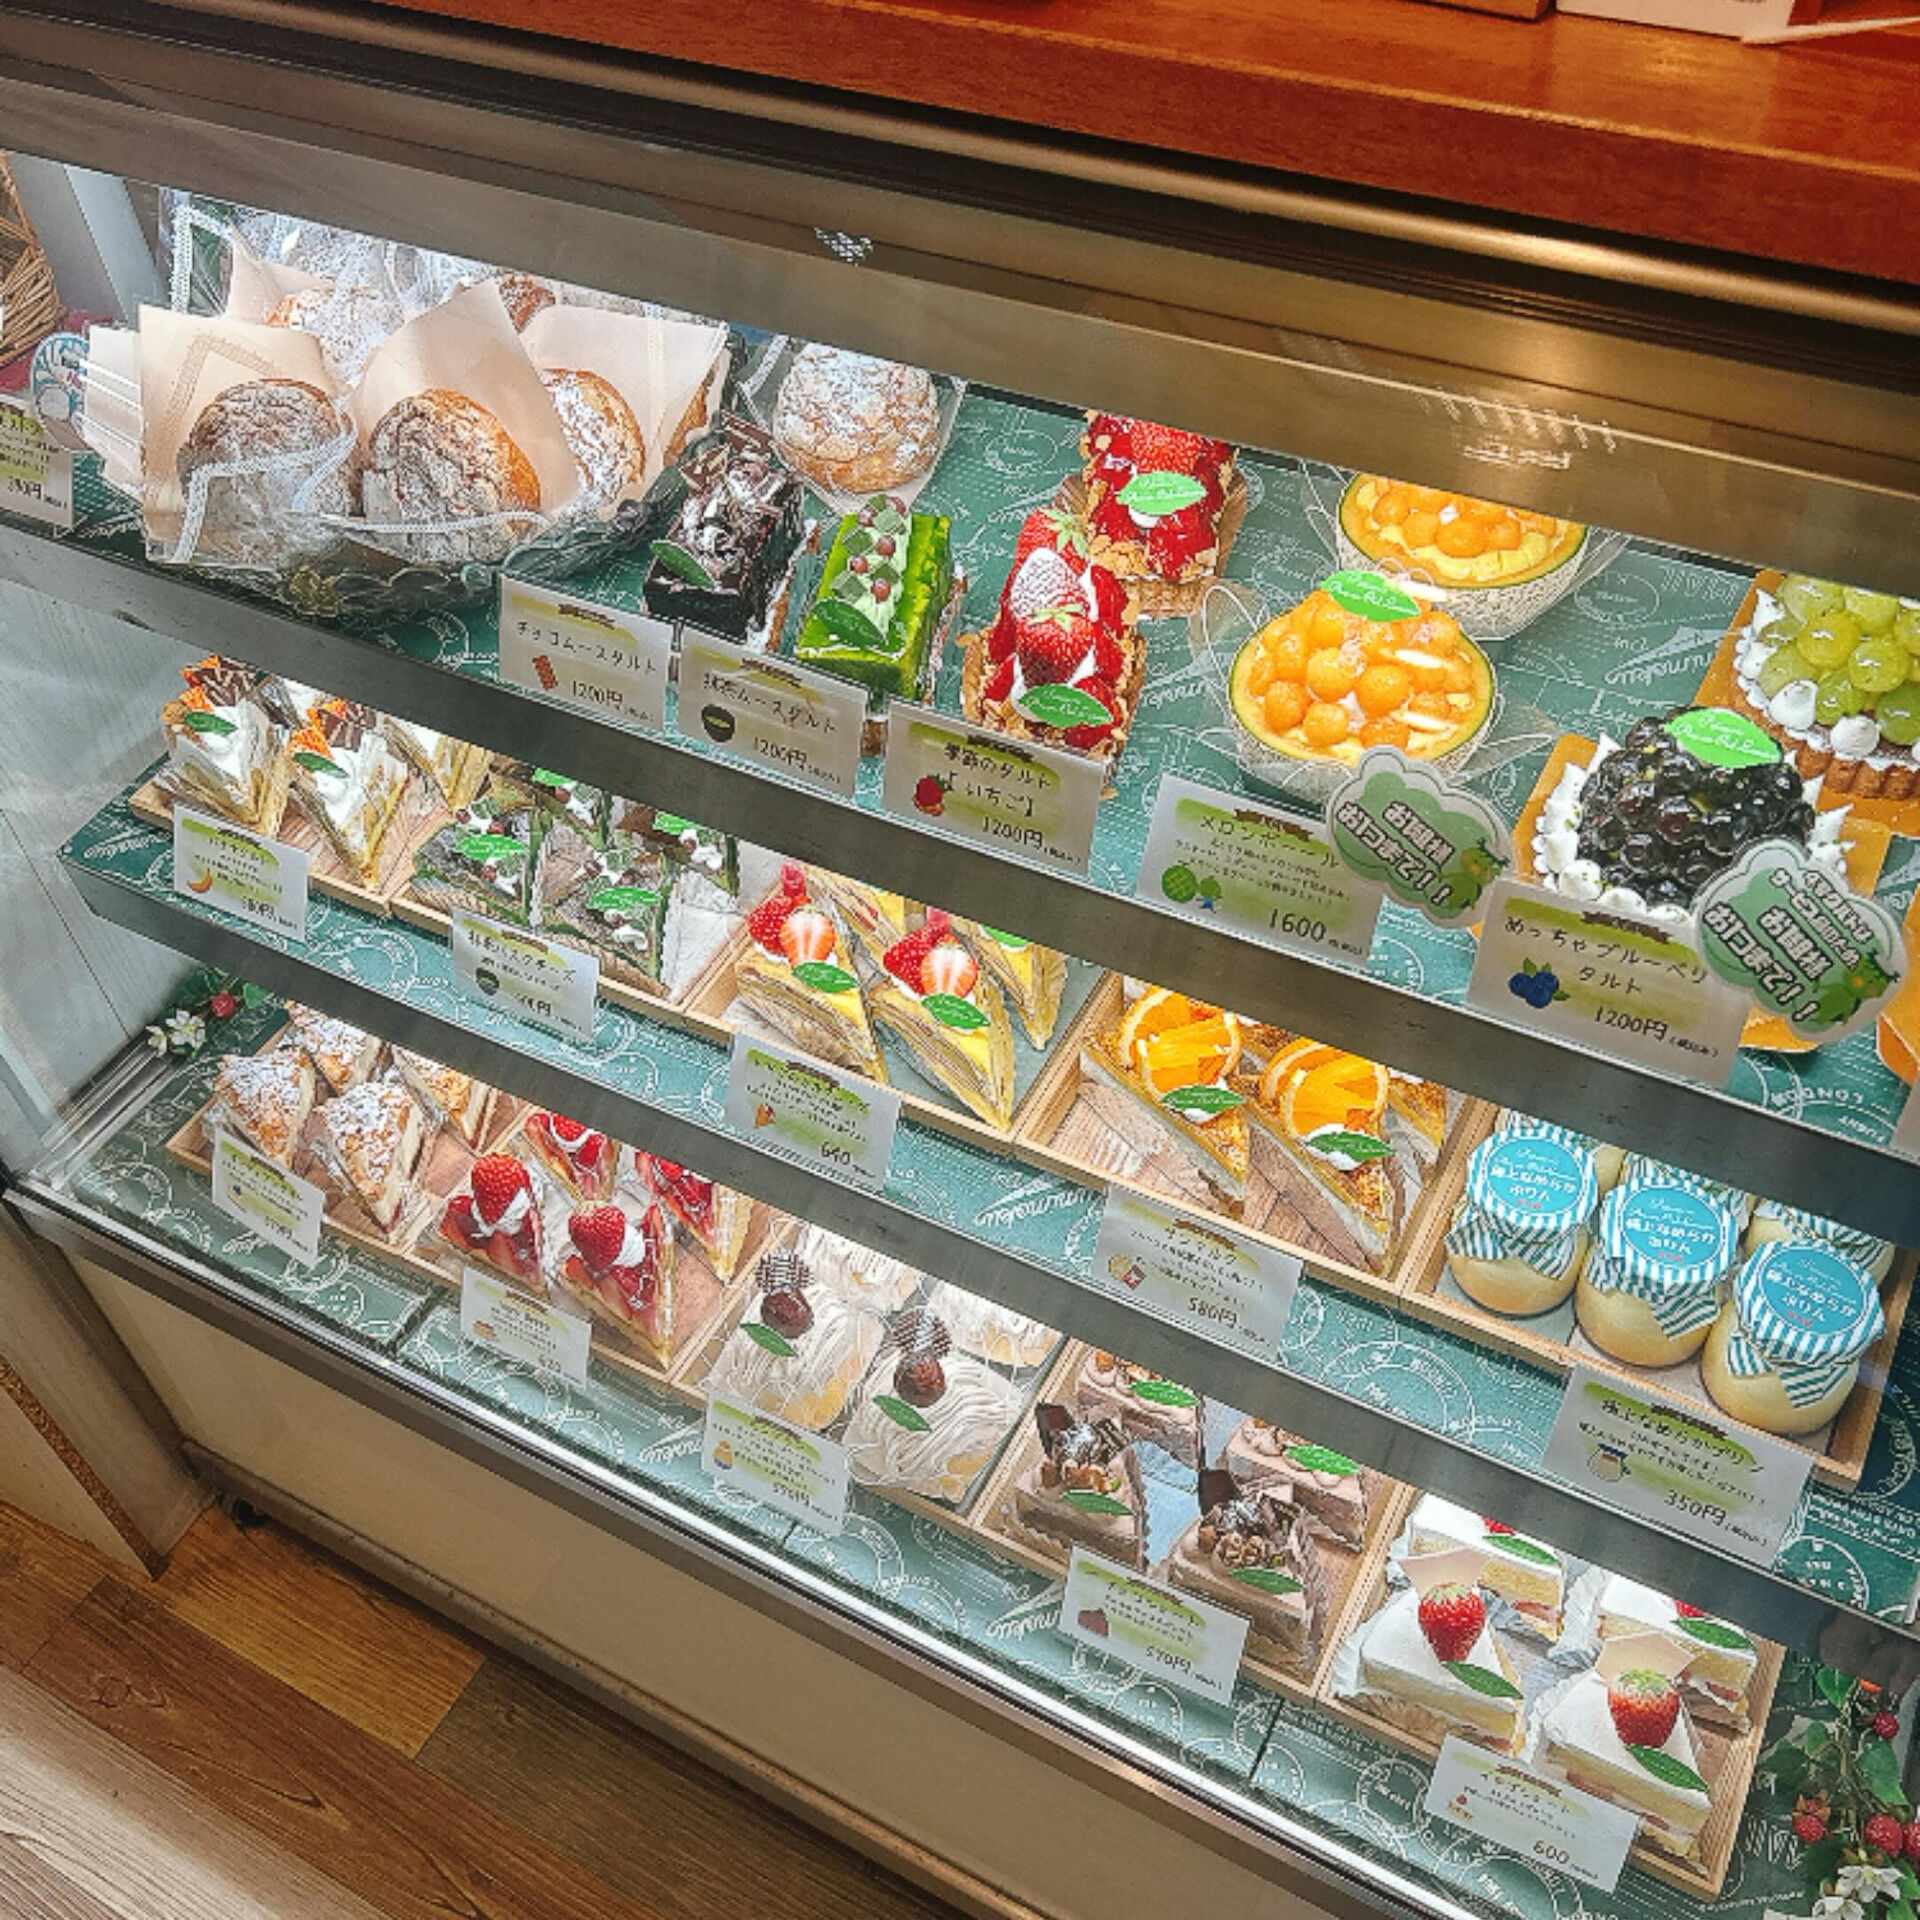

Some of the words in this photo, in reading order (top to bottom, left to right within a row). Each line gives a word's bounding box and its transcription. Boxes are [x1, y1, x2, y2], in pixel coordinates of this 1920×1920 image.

[1269, 908, 1327, 943] 1600
[1579, 966, 1642, 995] タルト
[1594, 1005, 1668, 1042] 1200円
[1663, 1489, 1727, 1527] 350円
[1532, 1840, 1570, 1865] 600
